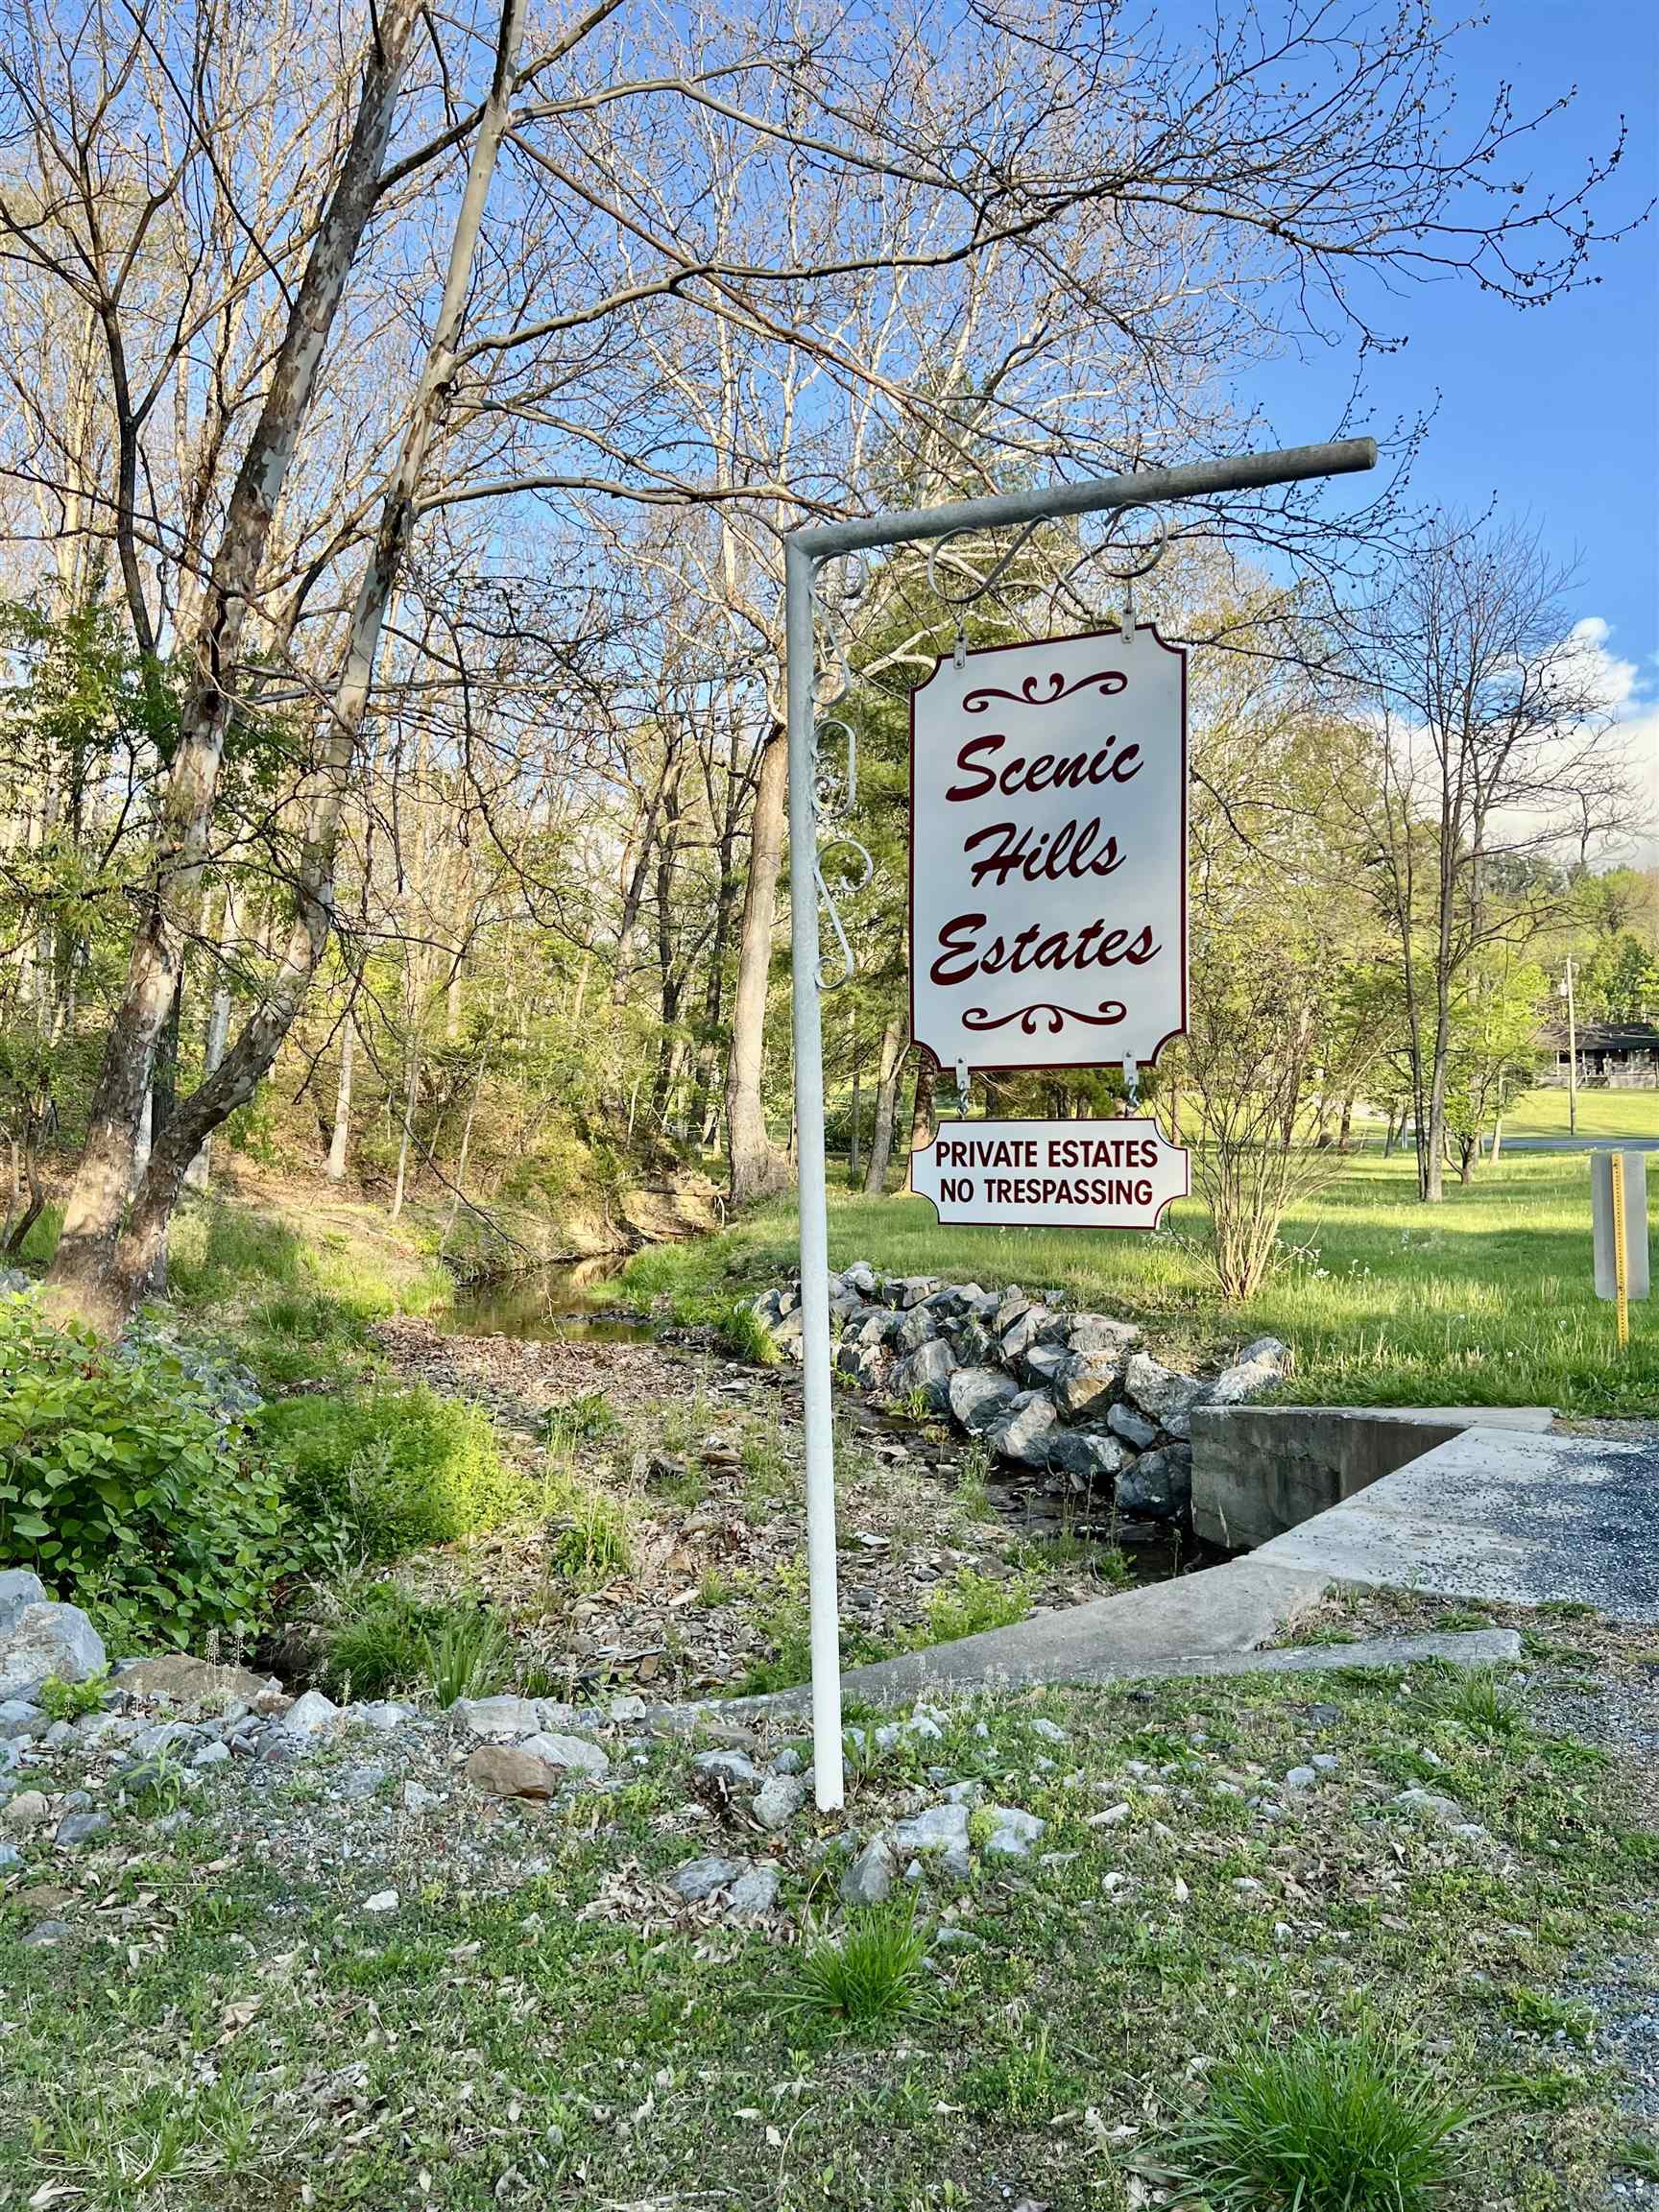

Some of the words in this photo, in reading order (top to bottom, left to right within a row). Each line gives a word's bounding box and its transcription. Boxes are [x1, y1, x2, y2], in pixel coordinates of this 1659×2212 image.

[945, 734, 1144, 803] Scenic
[964, 817, 1127, 888] Hills
[929, 912, 1163, 986] Estates
[935, 1141, 1038, 1168] PRIVATE
[1047, 1140, 1159, 1168] ESTATES
[940, 1178, 974, 1203] NO
[984, 1178, 1153, 1206] TRESPASSING
